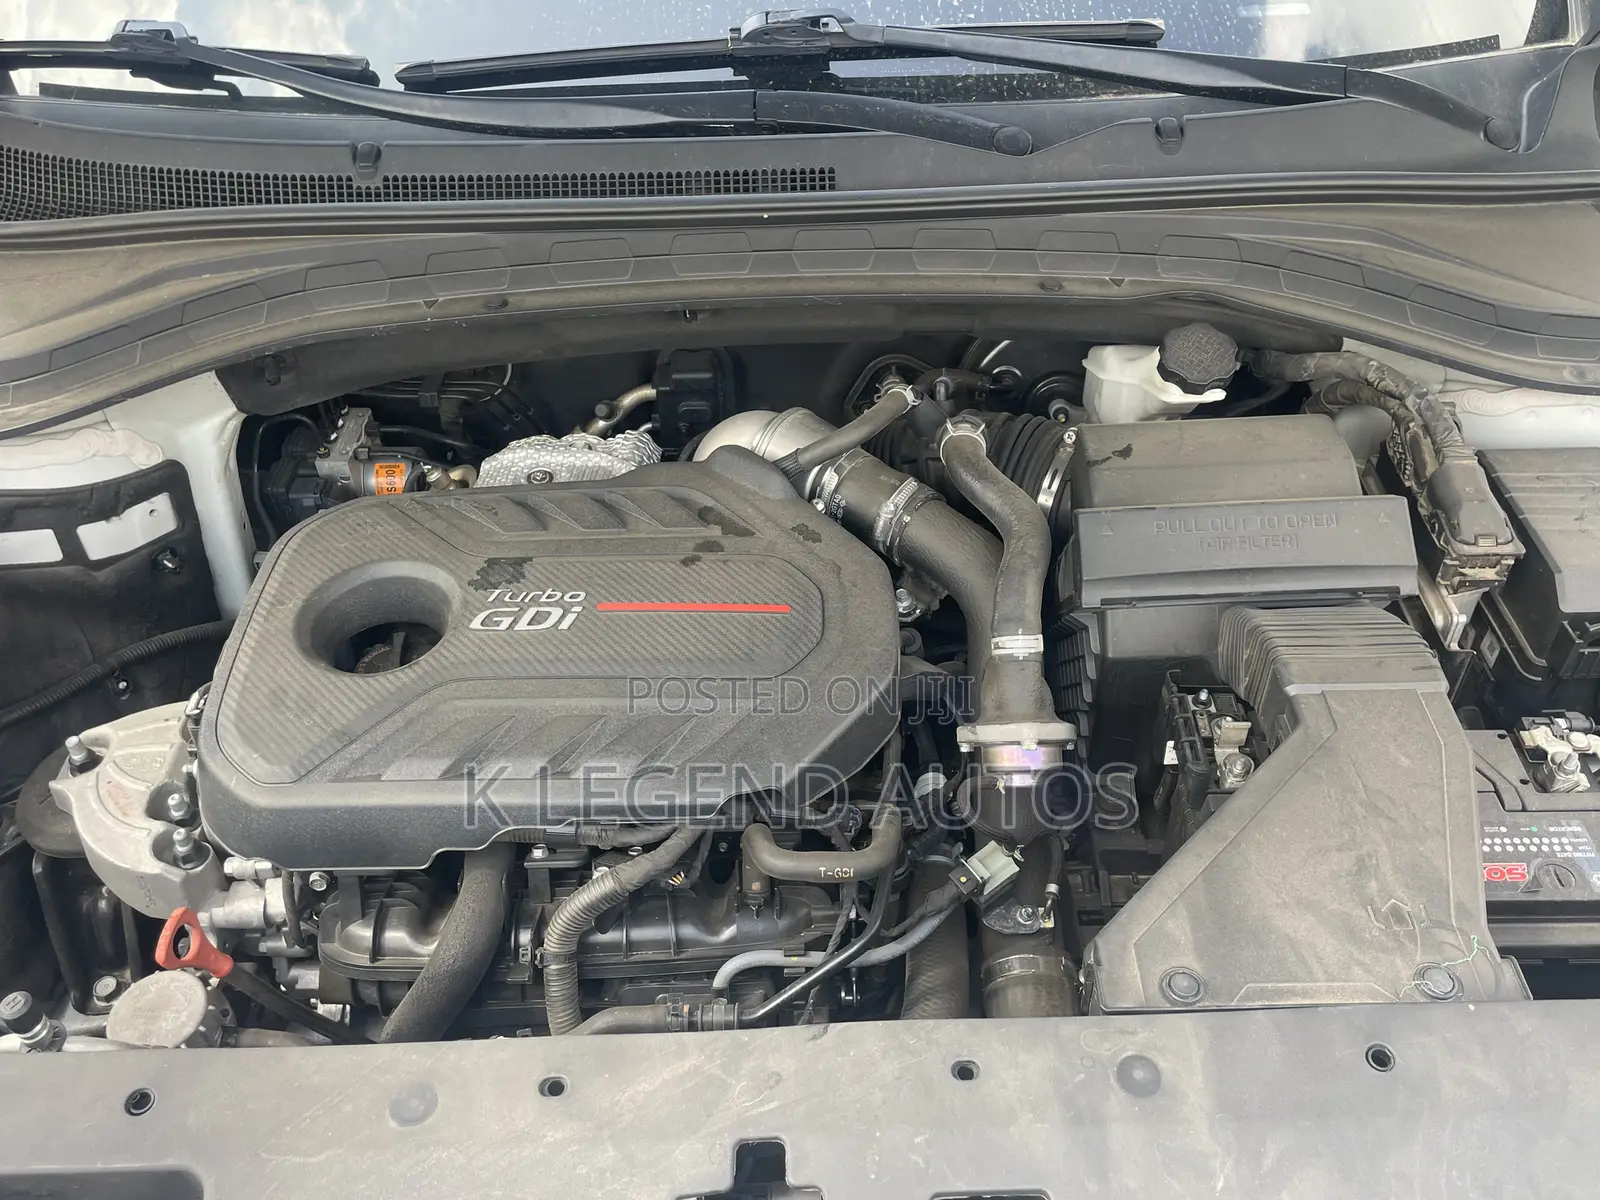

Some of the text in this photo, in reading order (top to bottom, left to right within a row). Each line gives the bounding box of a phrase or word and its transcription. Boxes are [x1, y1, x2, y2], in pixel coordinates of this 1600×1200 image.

[1153, 513, 1339, 535] PULL OUT TO OPEN
[1198, 533, 1299, 551] (AIR FILTER)
[486, 588, 587, 602] Turbo
[469, 606, 584, 631] GDi
[819, 867, 855, 878] T-GDI
